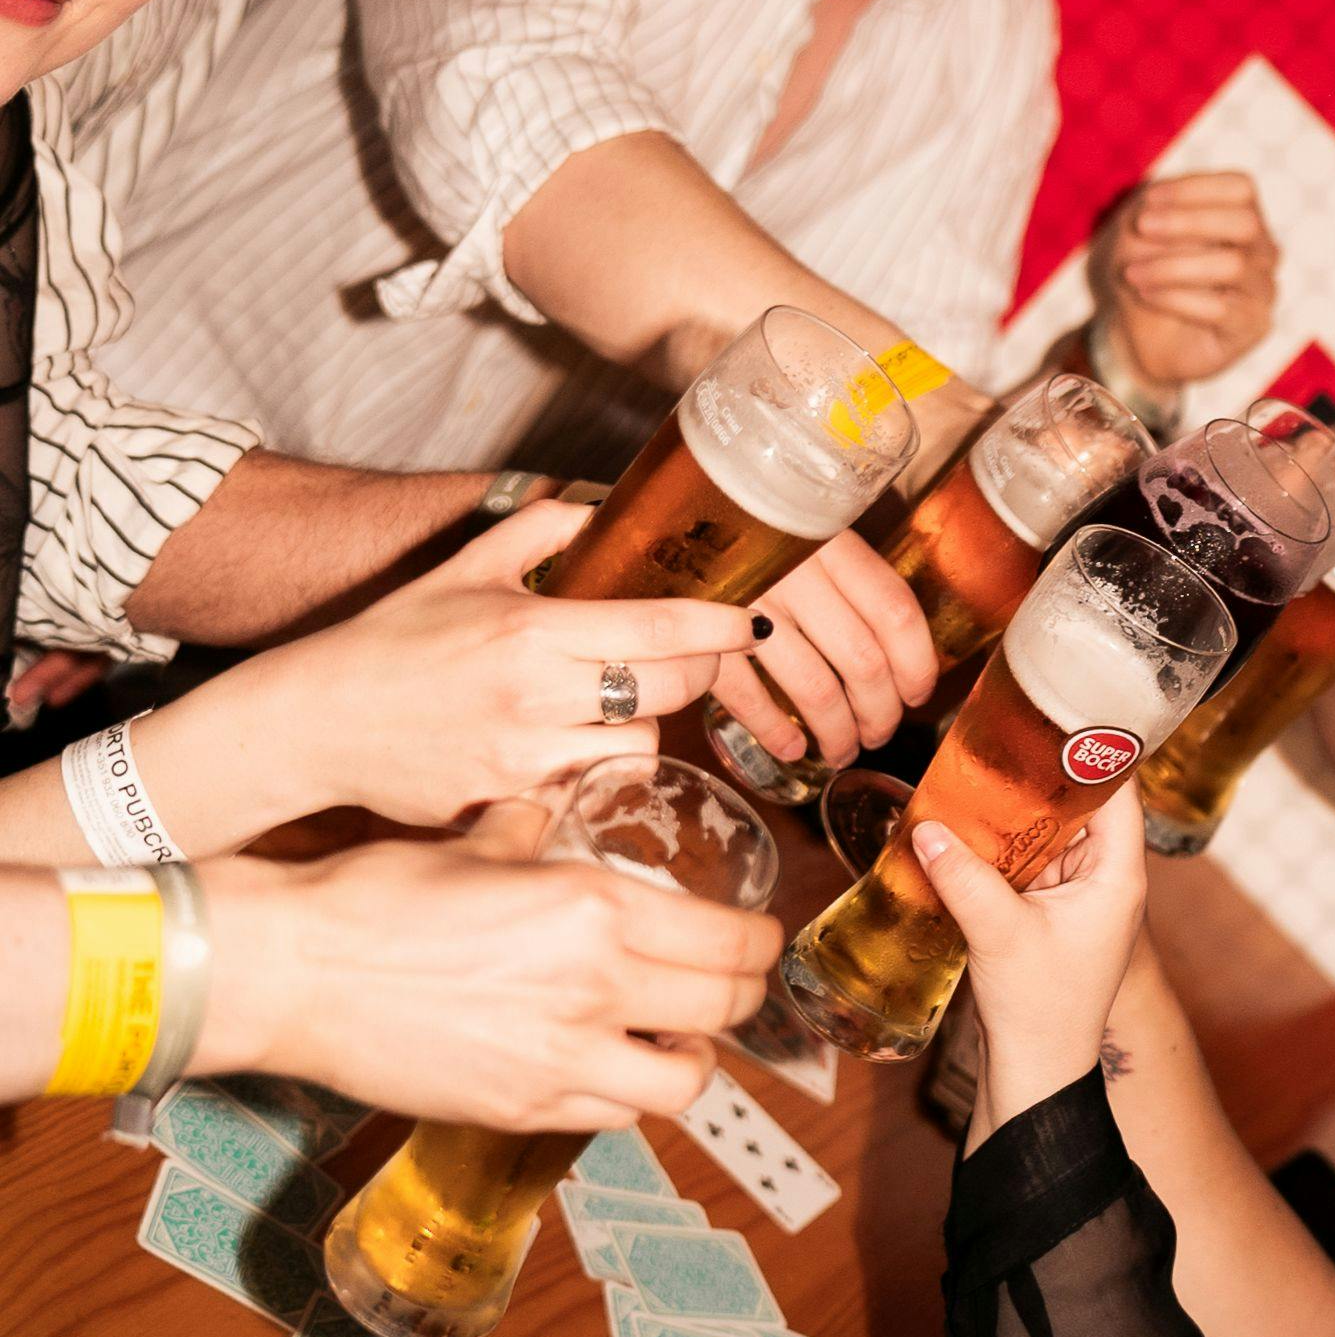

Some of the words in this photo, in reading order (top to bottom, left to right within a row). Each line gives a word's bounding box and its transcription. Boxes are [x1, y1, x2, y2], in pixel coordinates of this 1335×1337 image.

[1072, 750, 1119, 773] BOCK
[1079, 737, 1131, 763] SUPER
[118, 784, 172, 863] PUBCR
